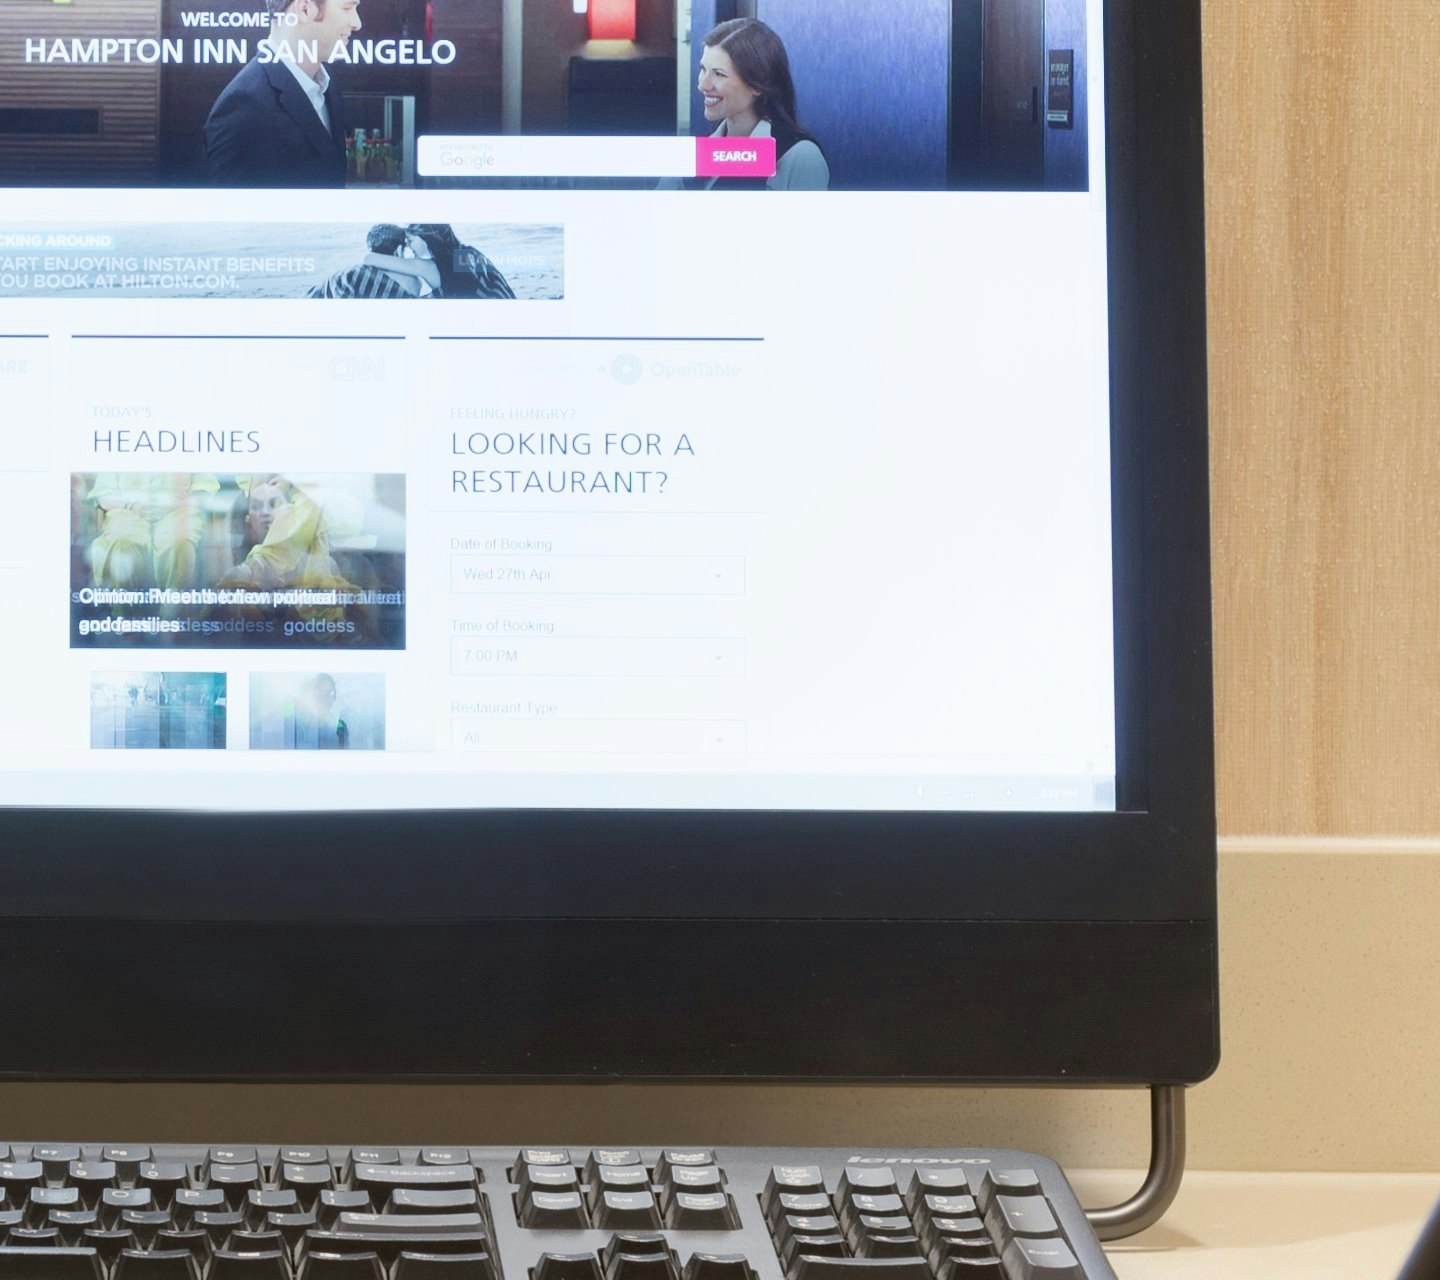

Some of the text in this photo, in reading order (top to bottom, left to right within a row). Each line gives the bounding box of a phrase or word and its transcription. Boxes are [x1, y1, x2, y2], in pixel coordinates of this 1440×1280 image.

[180, 11, 299, 28] WELCOME TO
[25, 37, 457, 65] HAMPTON INN SAN ANGELO
[440, 151, 495, 169] Google
[712, 150, 757, 162] SEARCH
[45, 234, 112, 247] AROUND
[44, 256, 138, 271] ENJOYING
[143, 256, 223, 271] INSTANT
[230, 257, 315, 272] BENEFITS
[34, 273, 90, 288] BOOK
[94, 273, 117, 288] AT
[121, 274, 240, 289] HILTON.COM.
[650, 360, 741, 379] OpenTable
[92, 406, 153, 418] TODAY'S
[450, 407, 576, 421] FEELING HUNGRY?
[93, 429, 261, 453] HEADLINES
[452, 431, 696, 456] LOOKING FOR A
[452, 469, 670, 495] RESTAURANT?
[450, 537, 553, 553] Date of Booking
[463, 567, 552, 584] Wed 27th Apr
[284, 618, 355, 636] goddess
[451, 619, 555, 635] Time of Booking
[496, 649, 518, 663] PM
[450, 700, 558, 716] Restaurant Type
[463, 731, 480, 745] All
[847, 1155, 992, 1164] lenovo
